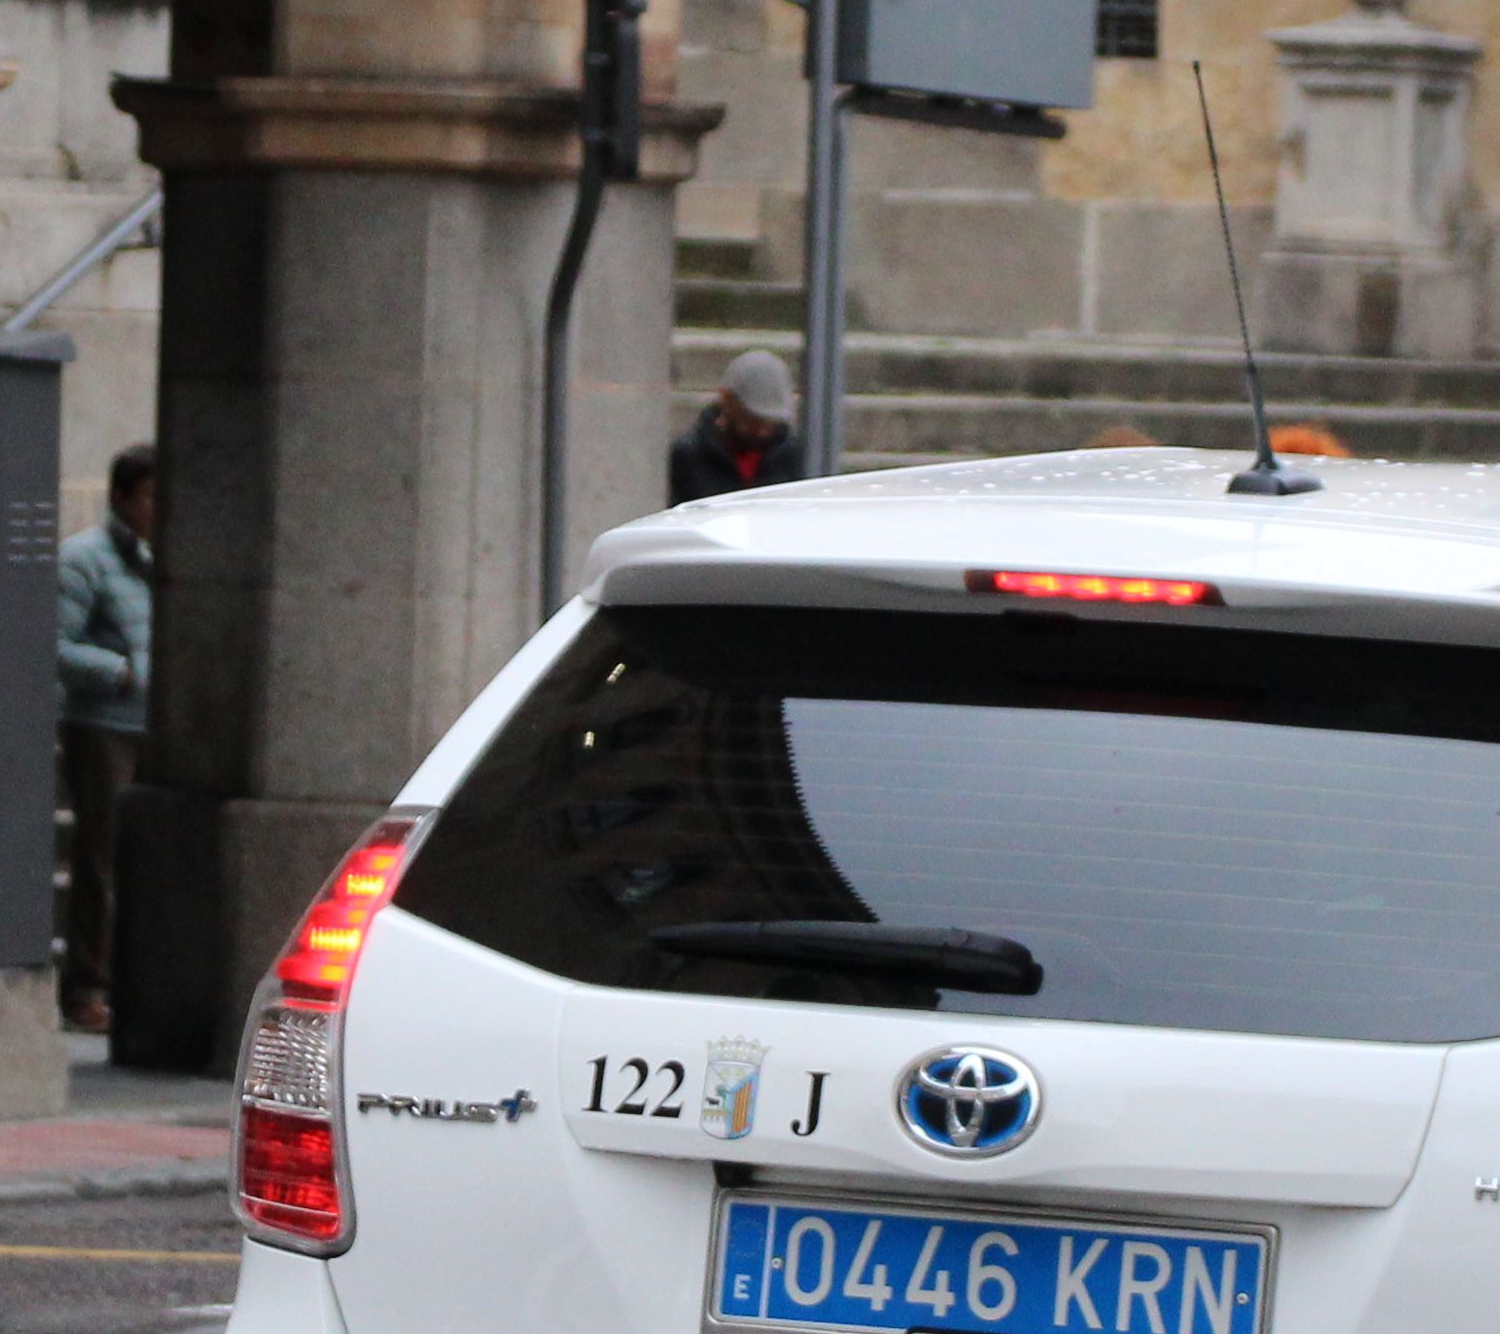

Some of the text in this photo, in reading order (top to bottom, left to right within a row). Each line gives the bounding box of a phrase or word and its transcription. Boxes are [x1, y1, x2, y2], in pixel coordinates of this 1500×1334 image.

[581, 1055, 831, 1137] 122 J
[732, 1274, 749, 1299] E
[784, 1216, 1019, 1321] 0446
